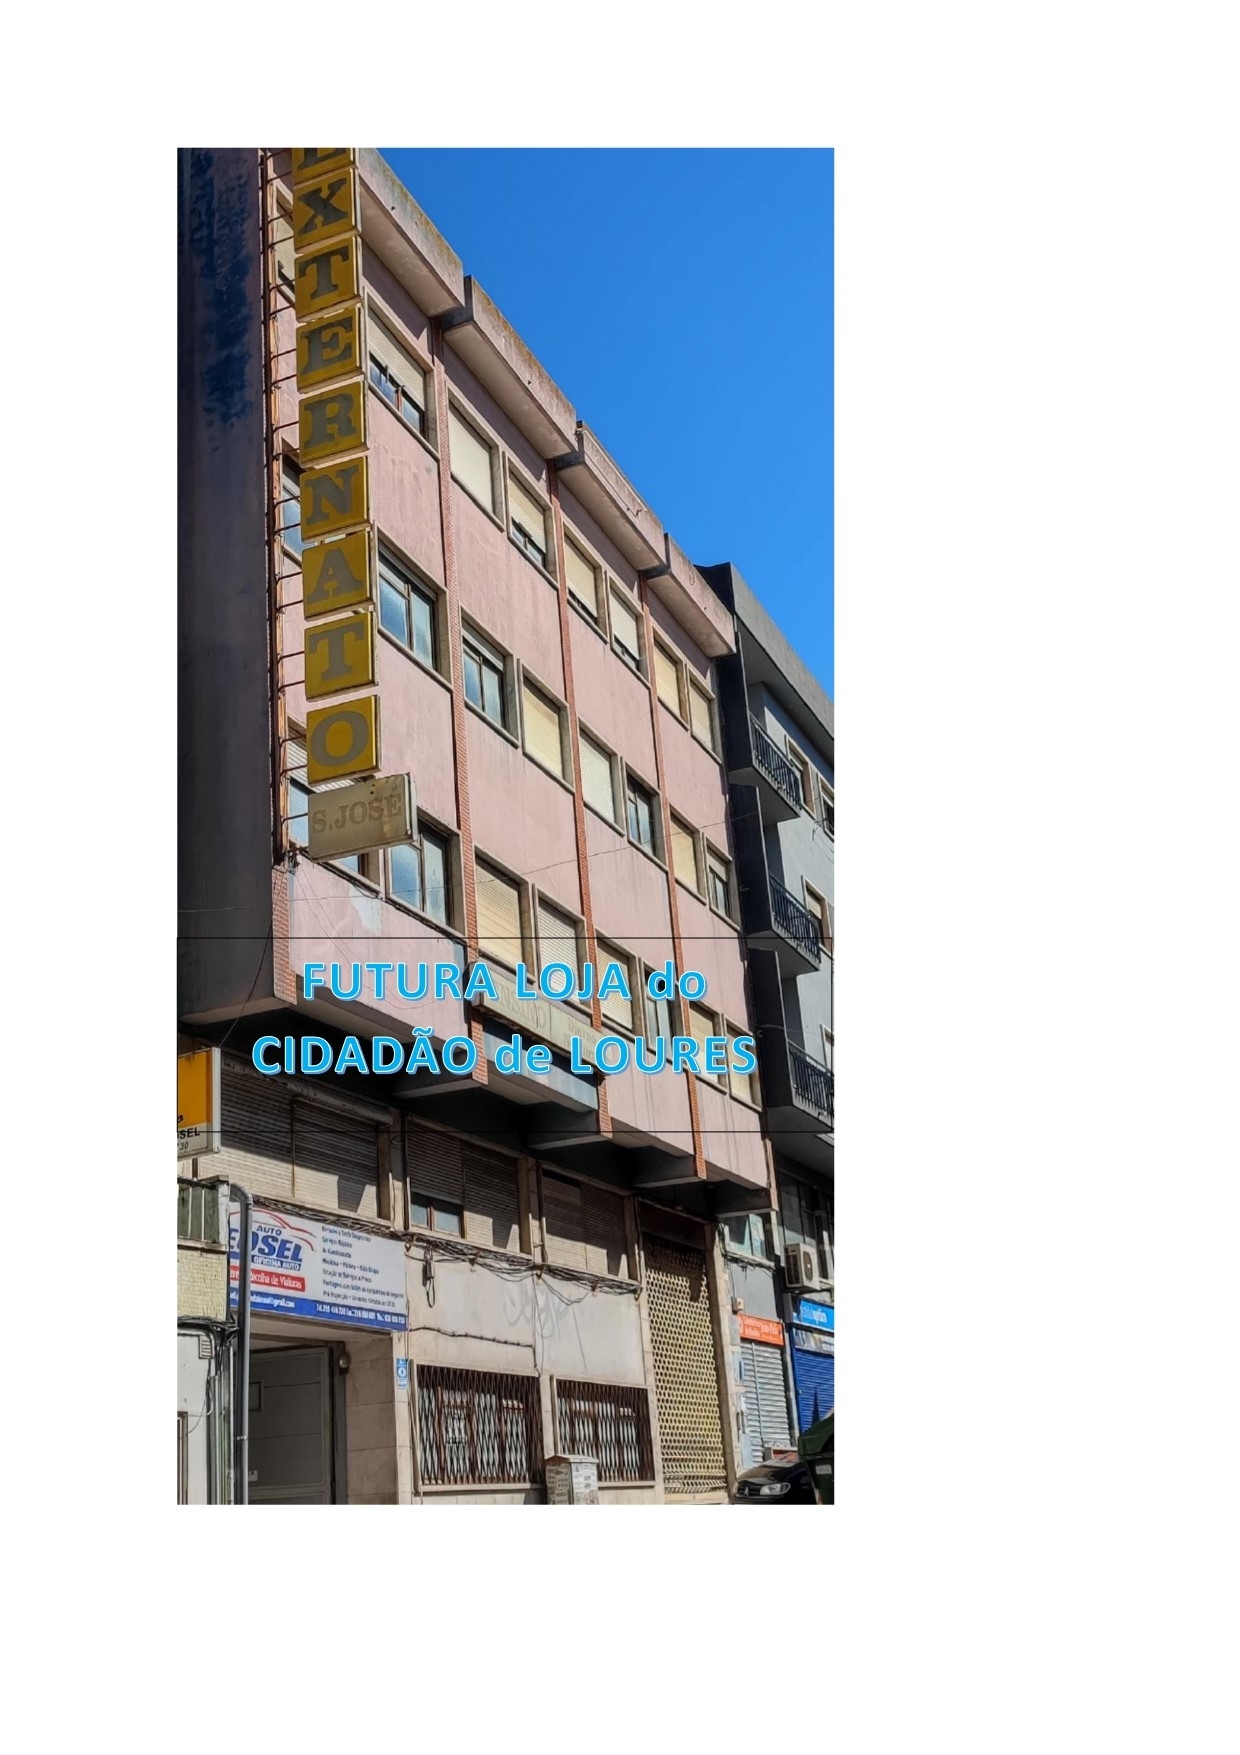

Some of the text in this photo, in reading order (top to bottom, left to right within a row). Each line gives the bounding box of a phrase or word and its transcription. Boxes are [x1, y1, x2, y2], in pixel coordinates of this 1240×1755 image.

[177, 1127, 201, 1140] SEL
[256, 1225, 282, 1237] AUTO
[253, 1256, 300, 1272] OFICINA AUTO
[271, 1274, 279, 1286] de
